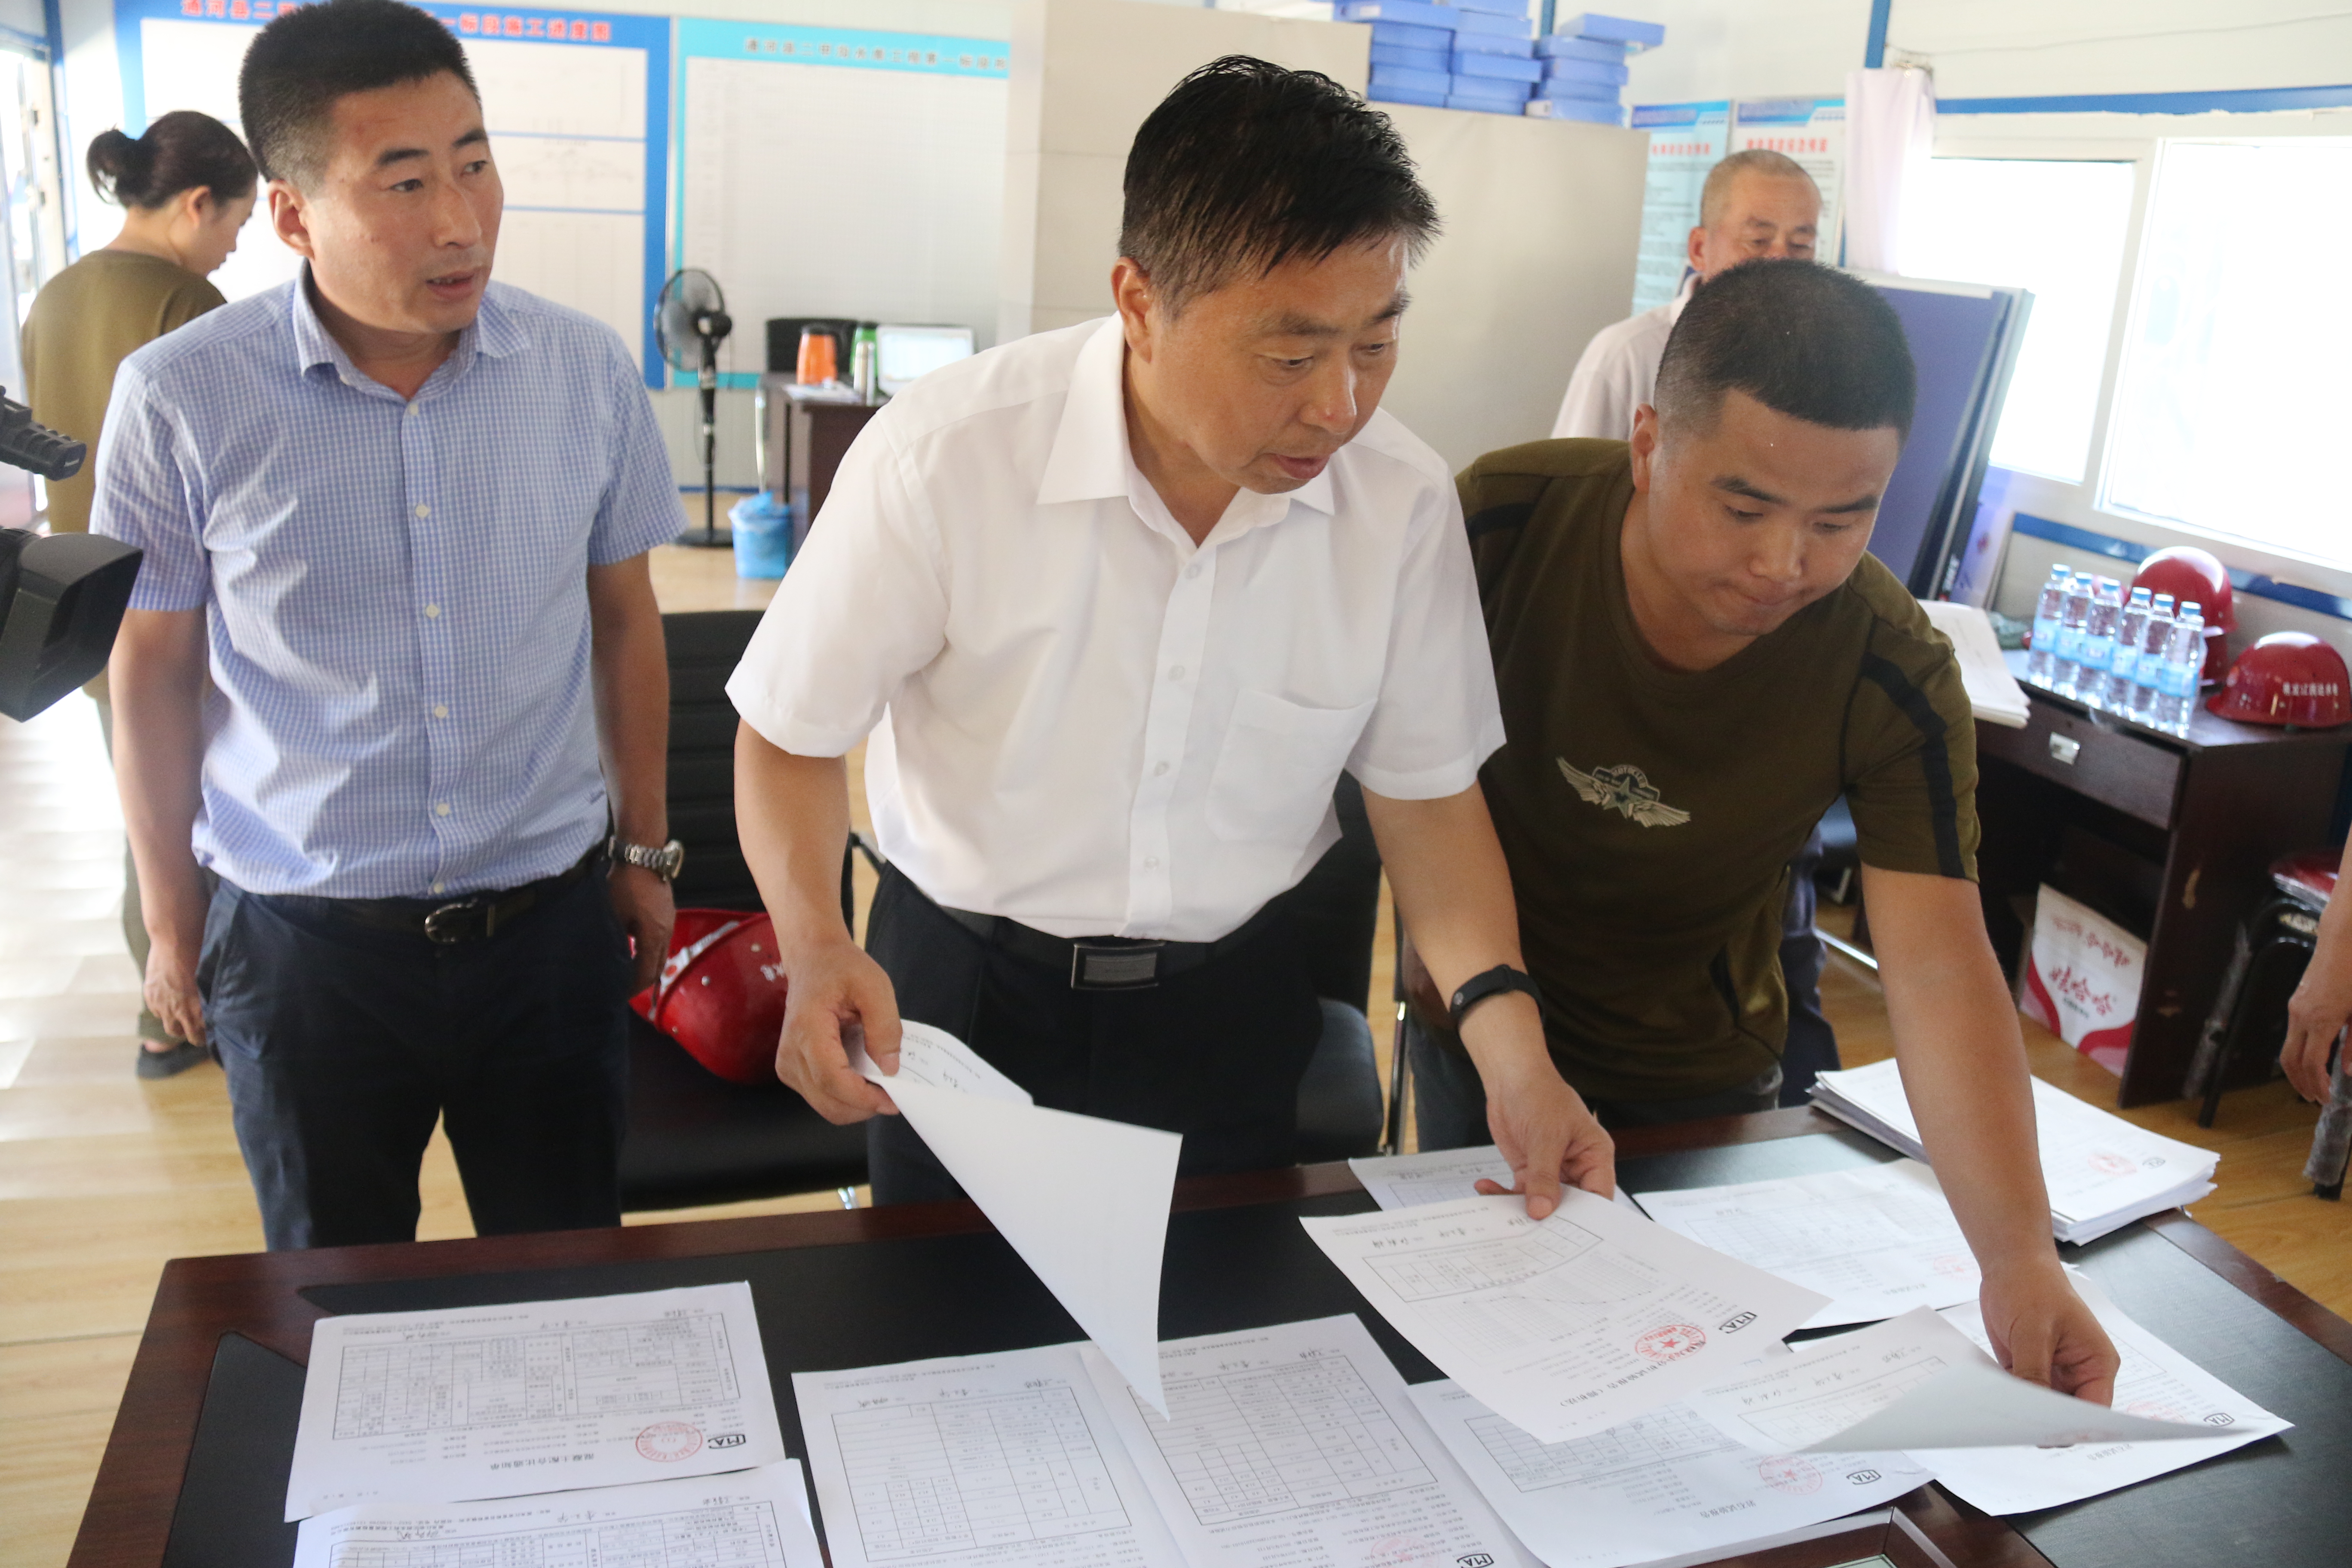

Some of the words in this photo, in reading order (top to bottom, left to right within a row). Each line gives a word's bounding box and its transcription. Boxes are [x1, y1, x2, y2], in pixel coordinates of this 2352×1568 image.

[2049, 966, 2113, 1016] 娃哈哈
[1463, 1554, 1488, 1568] MA
